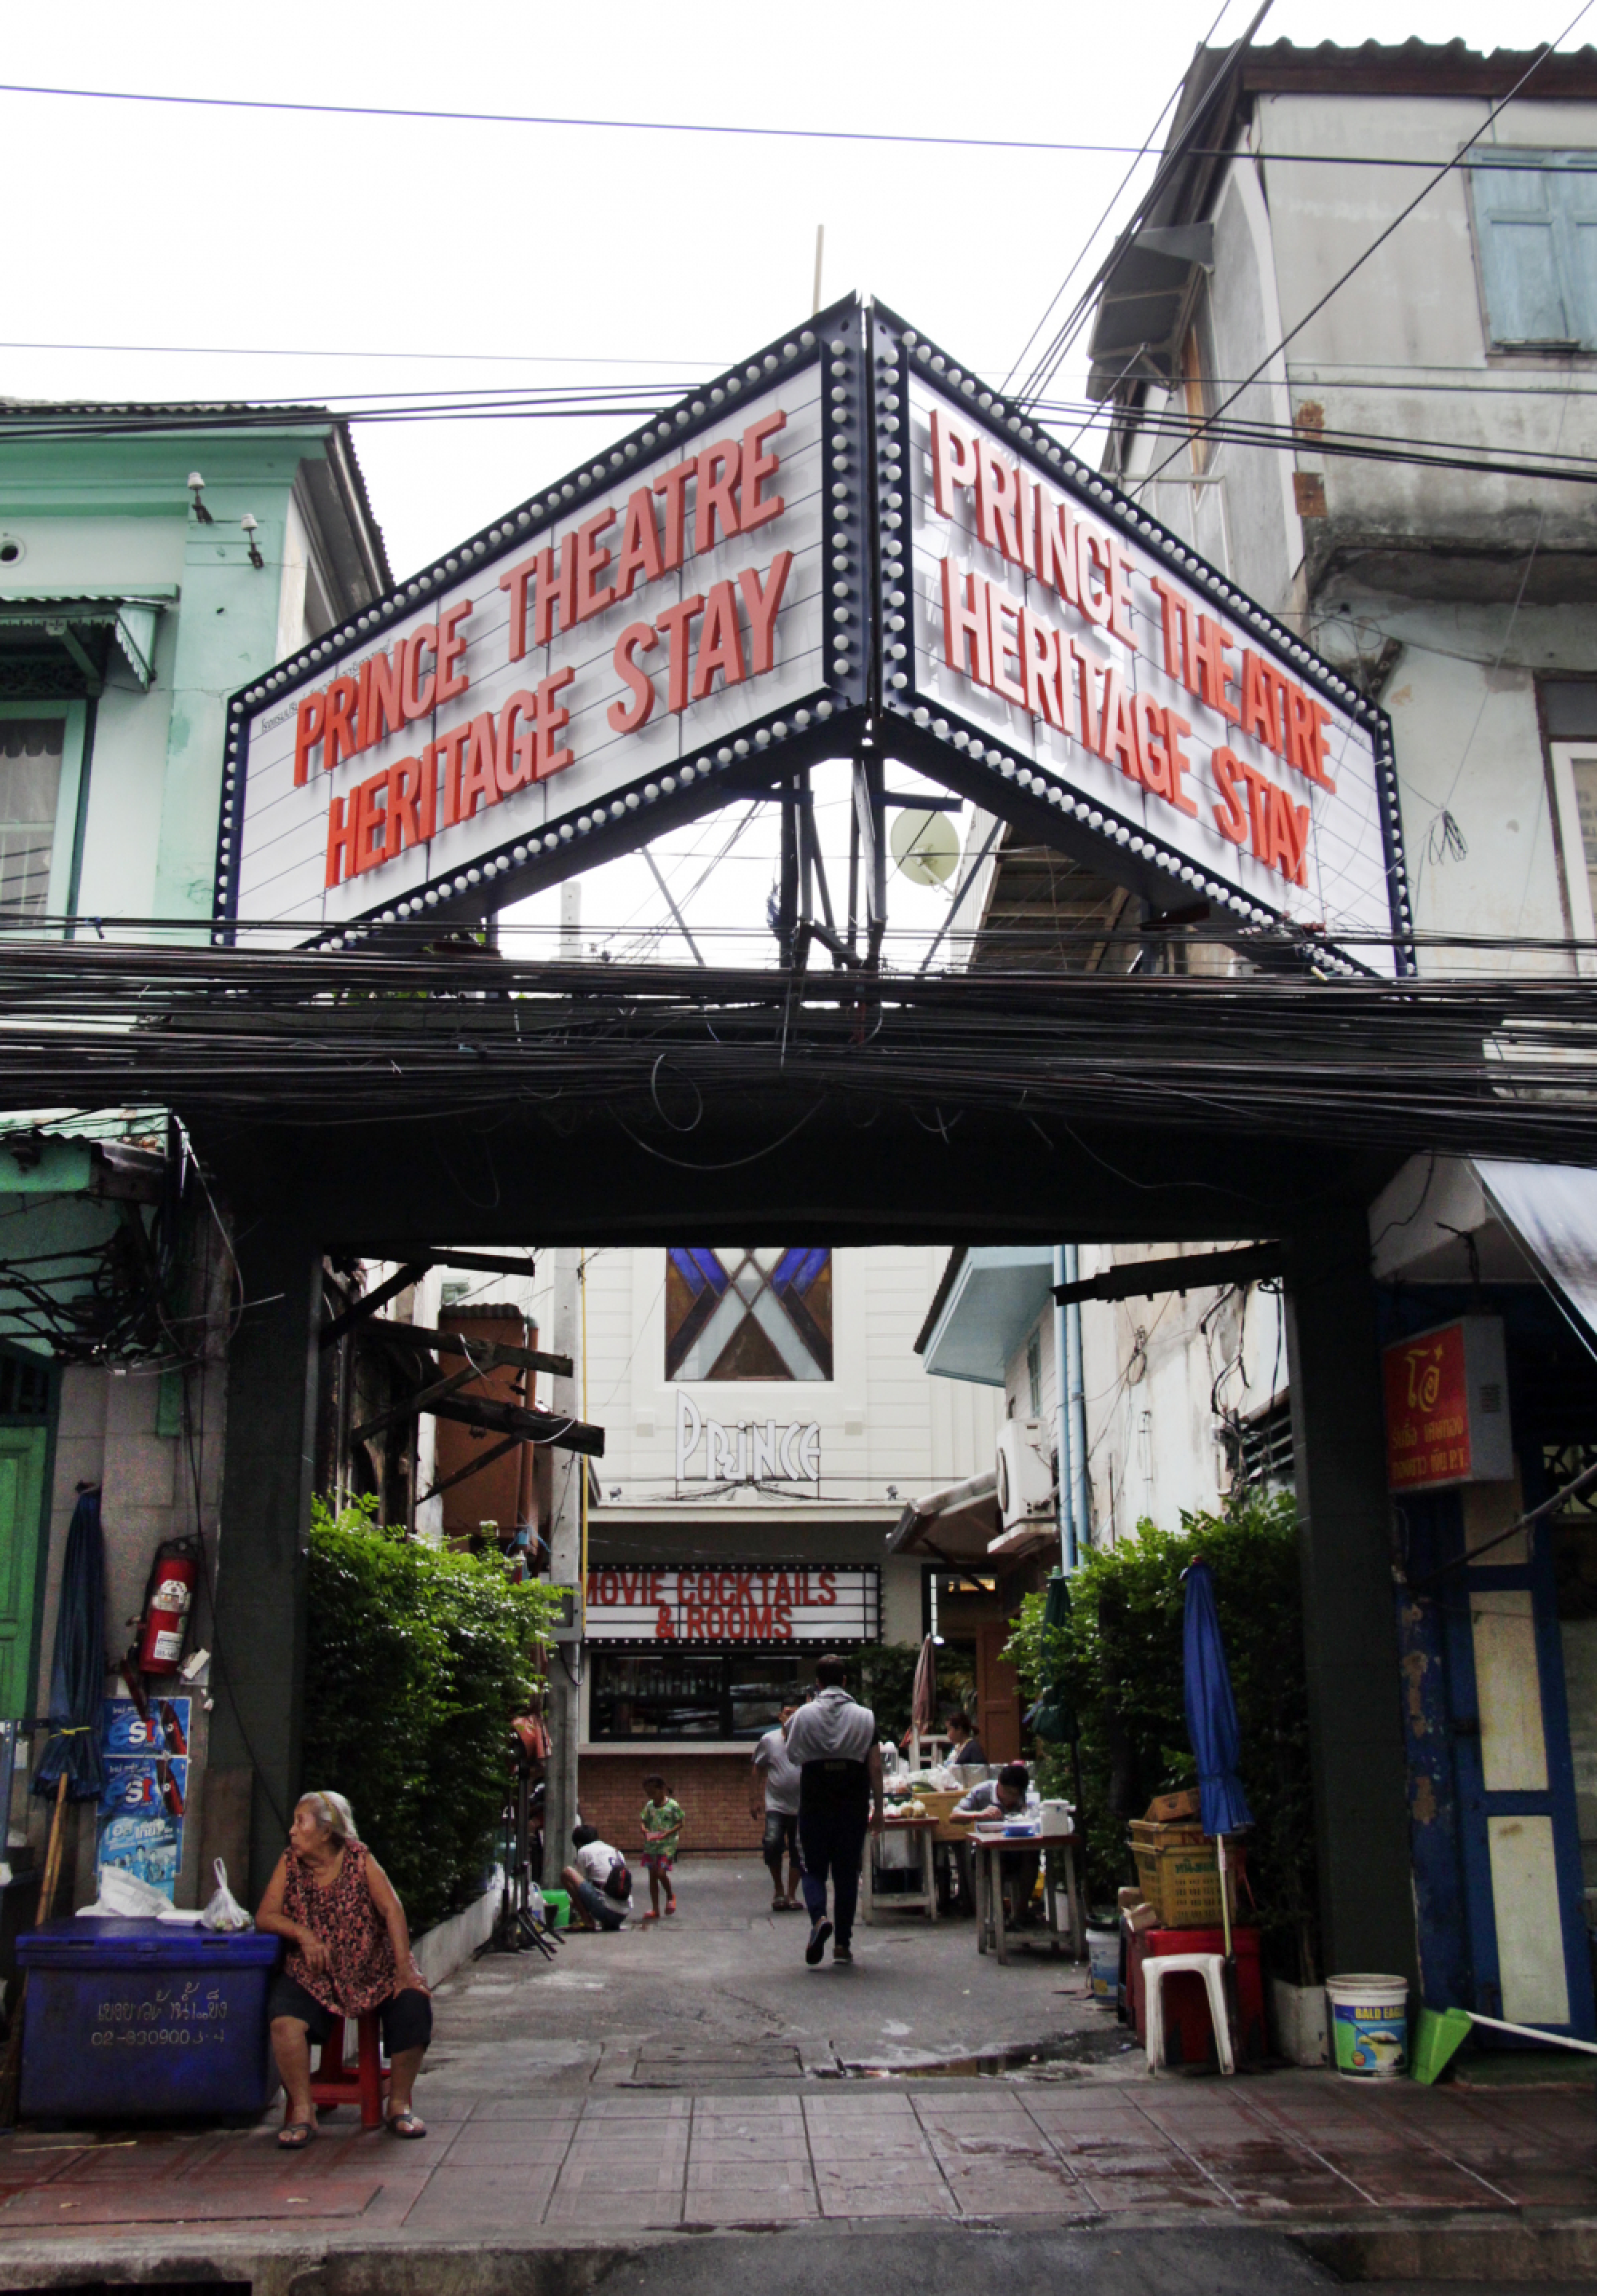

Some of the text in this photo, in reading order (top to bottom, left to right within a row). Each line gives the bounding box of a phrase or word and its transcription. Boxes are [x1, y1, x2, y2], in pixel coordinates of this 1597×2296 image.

[293, 600, 474, 787] PRINCE
[500, 410, 787, 663] THEATRE
[325, 667, 575, 889] HERITAGE
[607, 550, 793, 734] STAY
[929, 409, 1337, 794] PRINCE THEATRE
[941, 556, 1310, 889] HERITAGE STAY
[655, 1605, 793, 1638] & ROOMS
[677, 1572, 838, 1605] COCKTAILS
[1355, 2006, 1381, 2019] BALD
